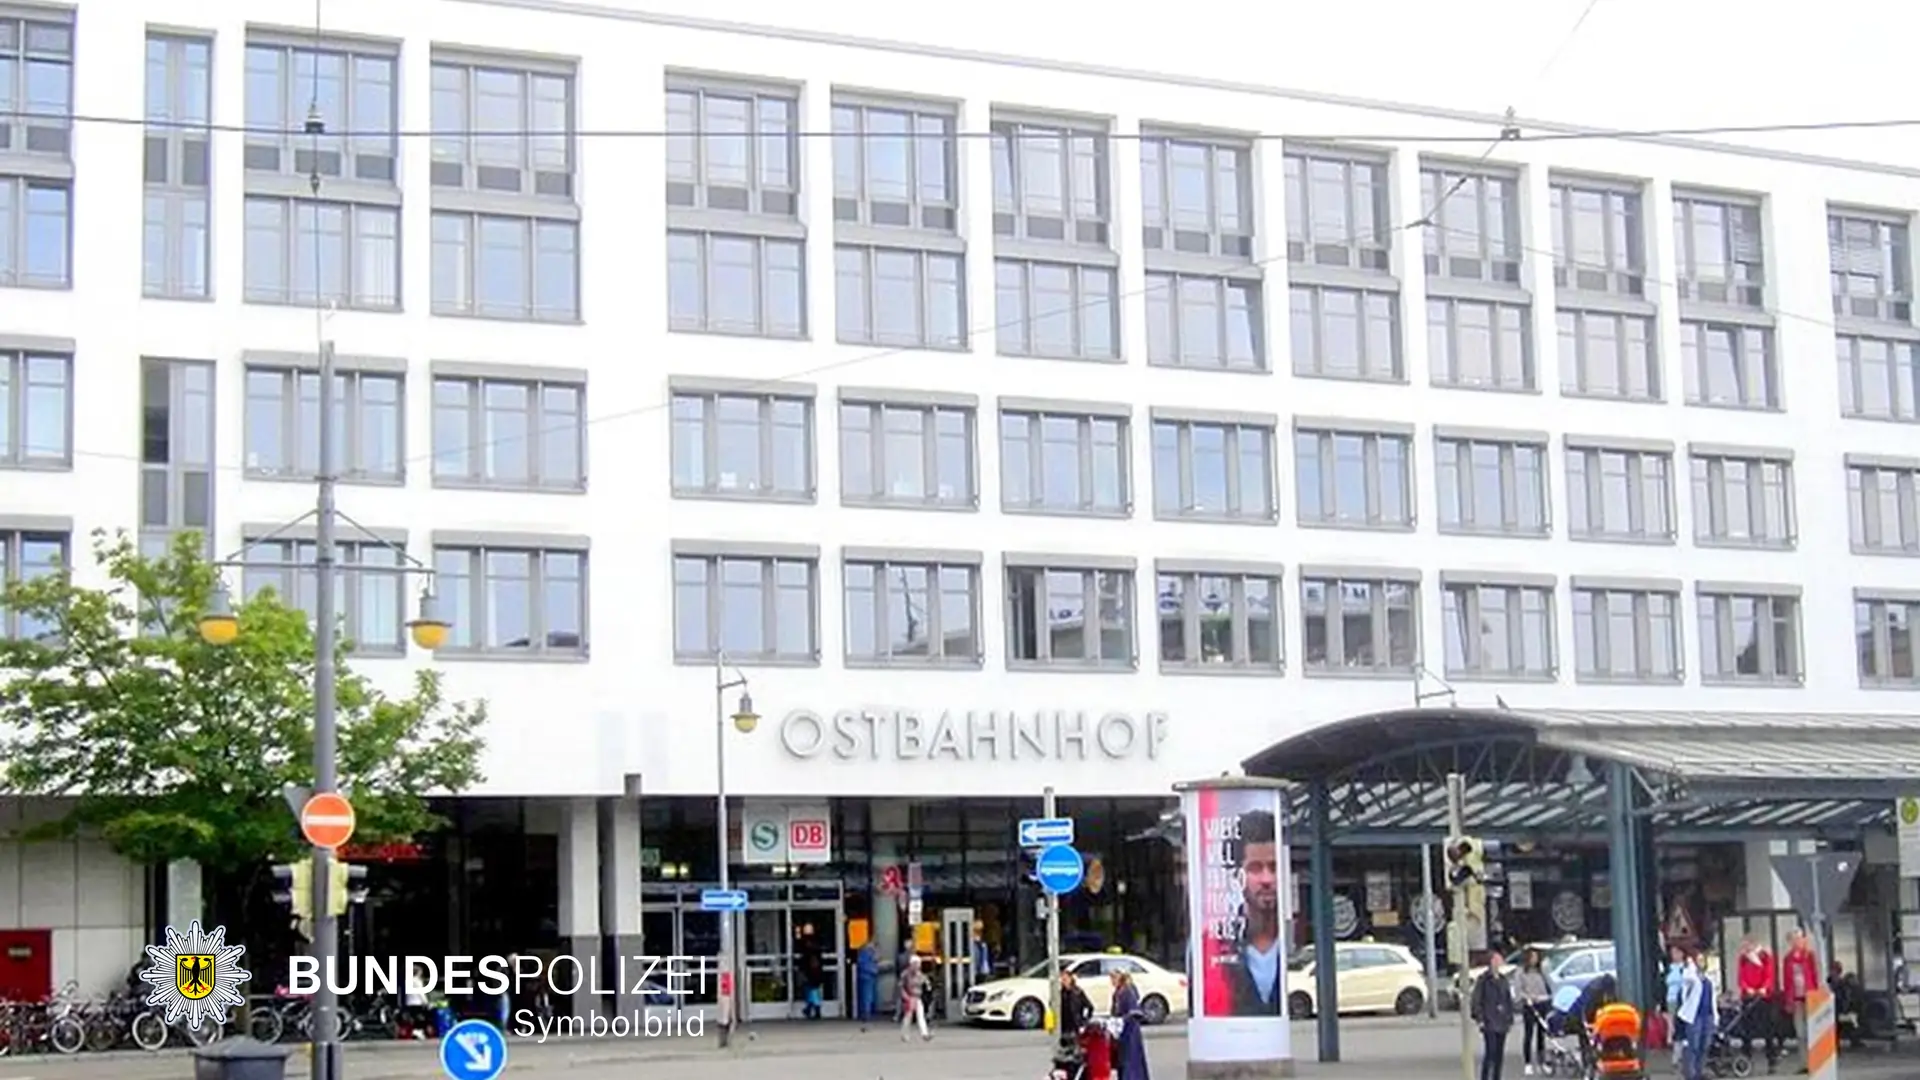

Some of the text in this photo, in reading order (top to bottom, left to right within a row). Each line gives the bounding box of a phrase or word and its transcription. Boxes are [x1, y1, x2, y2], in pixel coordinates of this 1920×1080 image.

[780, 709, 1169, 760] OSTBAHNHOF
[751, 821, 779, 850] S
[795, 825, 823, 844] DB
